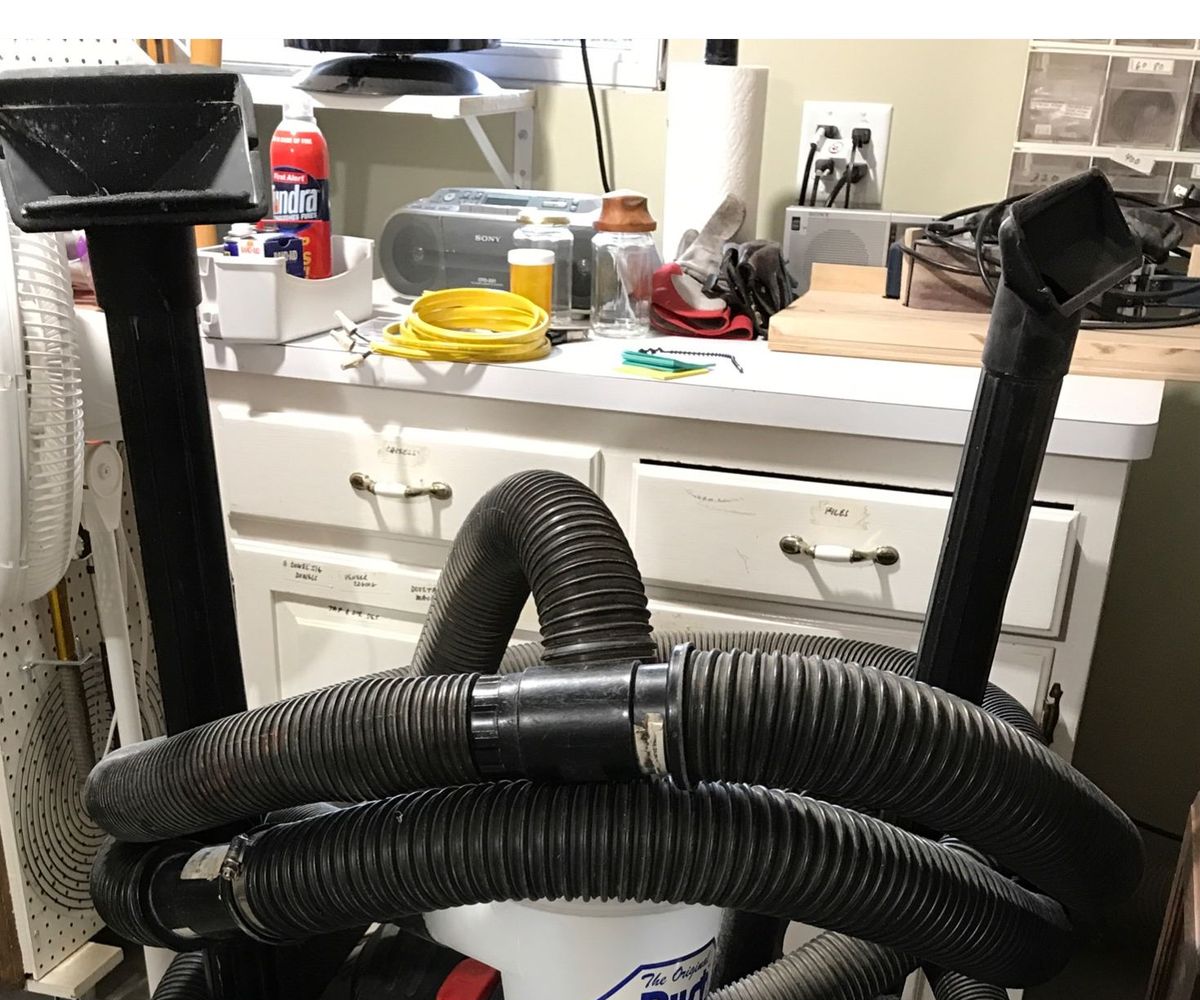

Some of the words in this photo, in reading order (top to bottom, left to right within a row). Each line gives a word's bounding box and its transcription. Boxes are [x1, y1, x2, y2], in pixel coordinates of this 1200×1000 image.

[271, 184, 318, 215] undra
[475, 234, 501, 243] SONY
[641, 972, 667, 989] The
